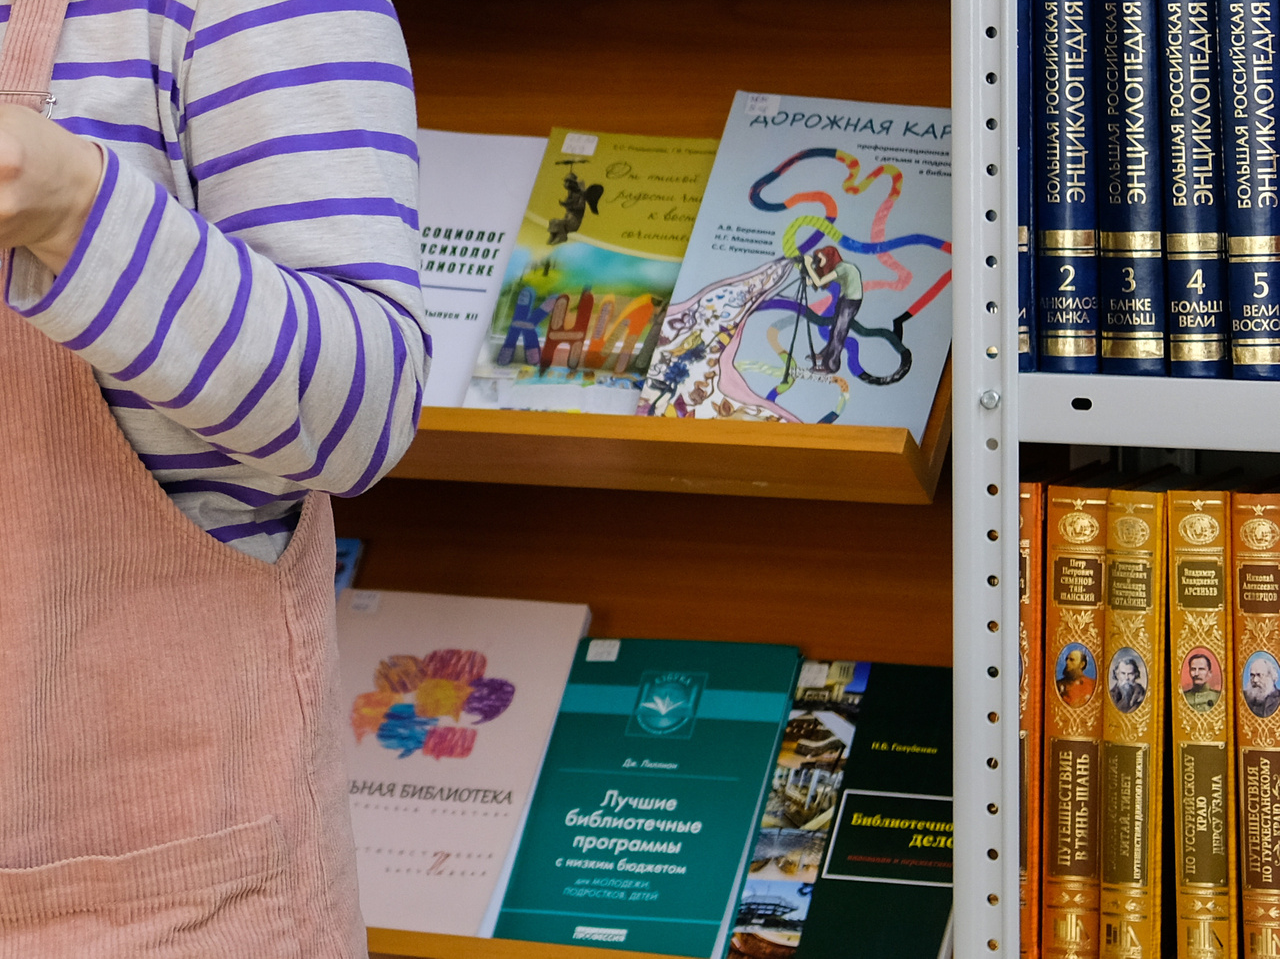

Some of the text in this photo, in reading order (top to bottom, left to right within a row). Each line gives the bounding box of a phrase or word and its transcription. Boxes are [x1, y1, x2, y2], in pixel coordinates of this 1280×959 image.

[1043, 1, 1061, 204] БОЛЬШАЯ РОССИЙСКАЯ
[1064, 1, 1089, 204] ЭНЦИКЛОПЕДИЯ
[1104, 2, 1122, 205] БОЛЬШАЯ РОССИЙСКАЯ
[1122, 1, 1149, 205] ЭНЦИКЛОПЕДИЯ
[1165, 2, 1188, 207] БОЛЬШАЯ РОССИЙСКАЯ
[1187, 1, 1216, 207] ЭНЦИКЛОПЕДИЯ
[1228, 2, 1252, 209] БОЛЬШАЯ РОССИЙСКАЯ
[1250, 1, 1280, 209] ЭНЦИКЛОПЕДИЯ
[750, 111, 893, 136] ДОРОЖНАЯ
[857, 143, 950, 157] профориентационная
[422, 226, 506, 244] СОЦИОЛОГ
[731, 236, 773, 246] Малахова
[1058, 264, 1076, 292] 2
[1121, 266, 1137, 293] 3
[1186, 268, 1206, 295] 4
[1252, 271, 1269, 299] 5
[1047, 310, 1090, 324] БАНКА
[1110, 298, 1152, 312] БАНКЕ
[1171, 300, 1223, 314] БОЛЬШ
[1107, 312, 1156, 326] БОЛЬШ
[1179, 314, 1215, 328] ВЕЛИ
[1184, 587, 1218, 597] АРСЕНЬЕВ
[891, 743, 939, 755] Голубенко
[399, 784, 513, 805] БИБЛИОТЕКА
[600, 789, 678, 813] Лучшие
[1120, 772, 1132, 805] ТИБЕТ
[565, 808, 703, 834] библиотечные
[1057, 750, 1073, 867] ПУТЕШЕСТВИЕ
[1075, 753, 1090, 862] В ТЯНЬ-ШАНЬ
[1183, 753, 1196, 875] ПО УССУРИЙСКОМУ
[1196, 796, 1208, 832] КРАЮ
[1211, 774, 1225, 856] ДЕРСУ УЗАЛА
[1246, 765, 1262, 873] ПУТЕШЕСТВИЯ
[1259, 757, 1273, 883] ПО ТУРКЕСТАНСКОМУ
[572, 835, 683, 855] программы
[555, 857, 687, 875] с низким бюджетом
